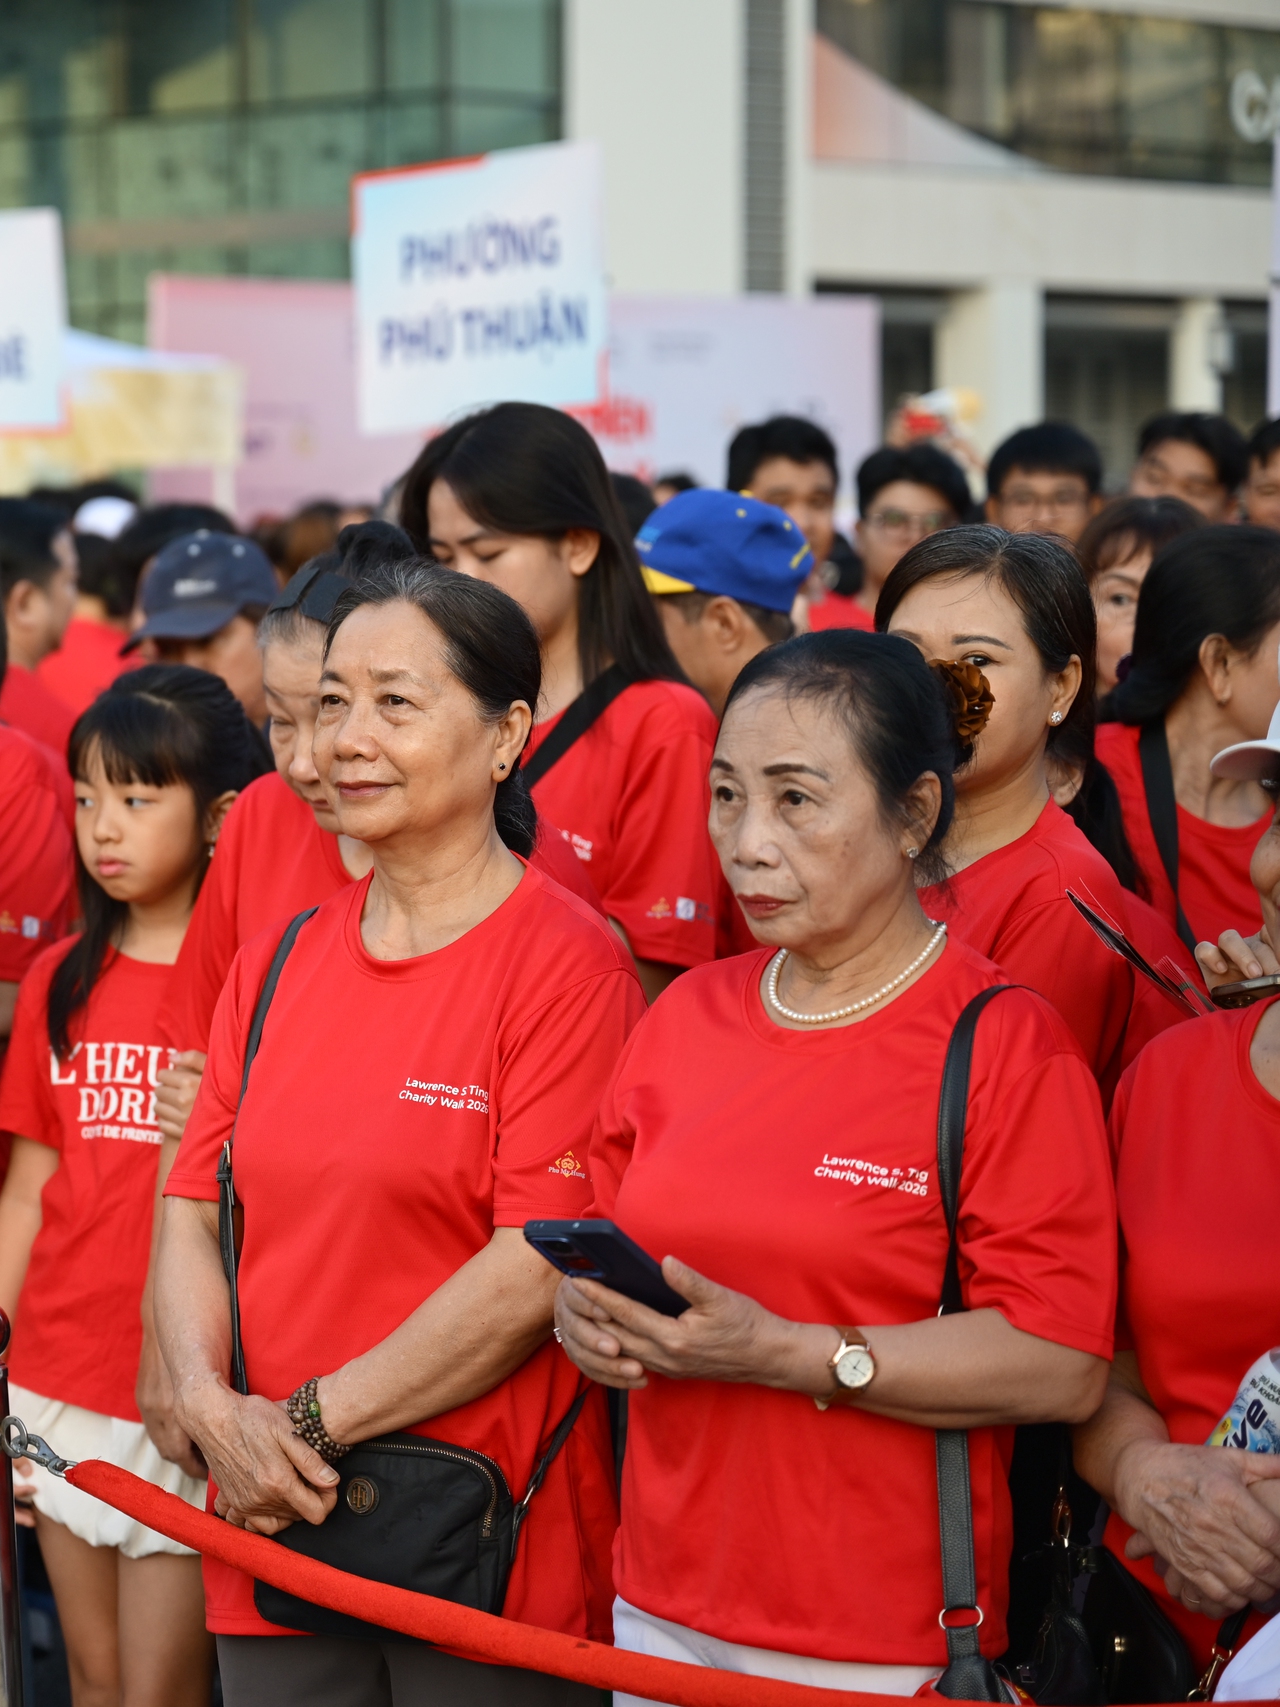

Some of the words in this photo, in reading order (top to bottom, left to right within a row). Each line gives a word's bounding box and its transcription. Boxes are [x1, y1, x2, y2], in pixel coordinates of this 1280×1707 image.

[405, 1077, 459, 1095] Lawrence
[469, 1084, 489, 1102] Ting
[399, 1090, 438, 1106] Charity
[440, 1095, 465, 1110] Walk
[466, 1098, 489, 1114] 2026
[822, 1153, 889, 1176] Lawrence
[814, 1166, 864, 1186] Charity
[897, 1179, 928, 1197] 2026
